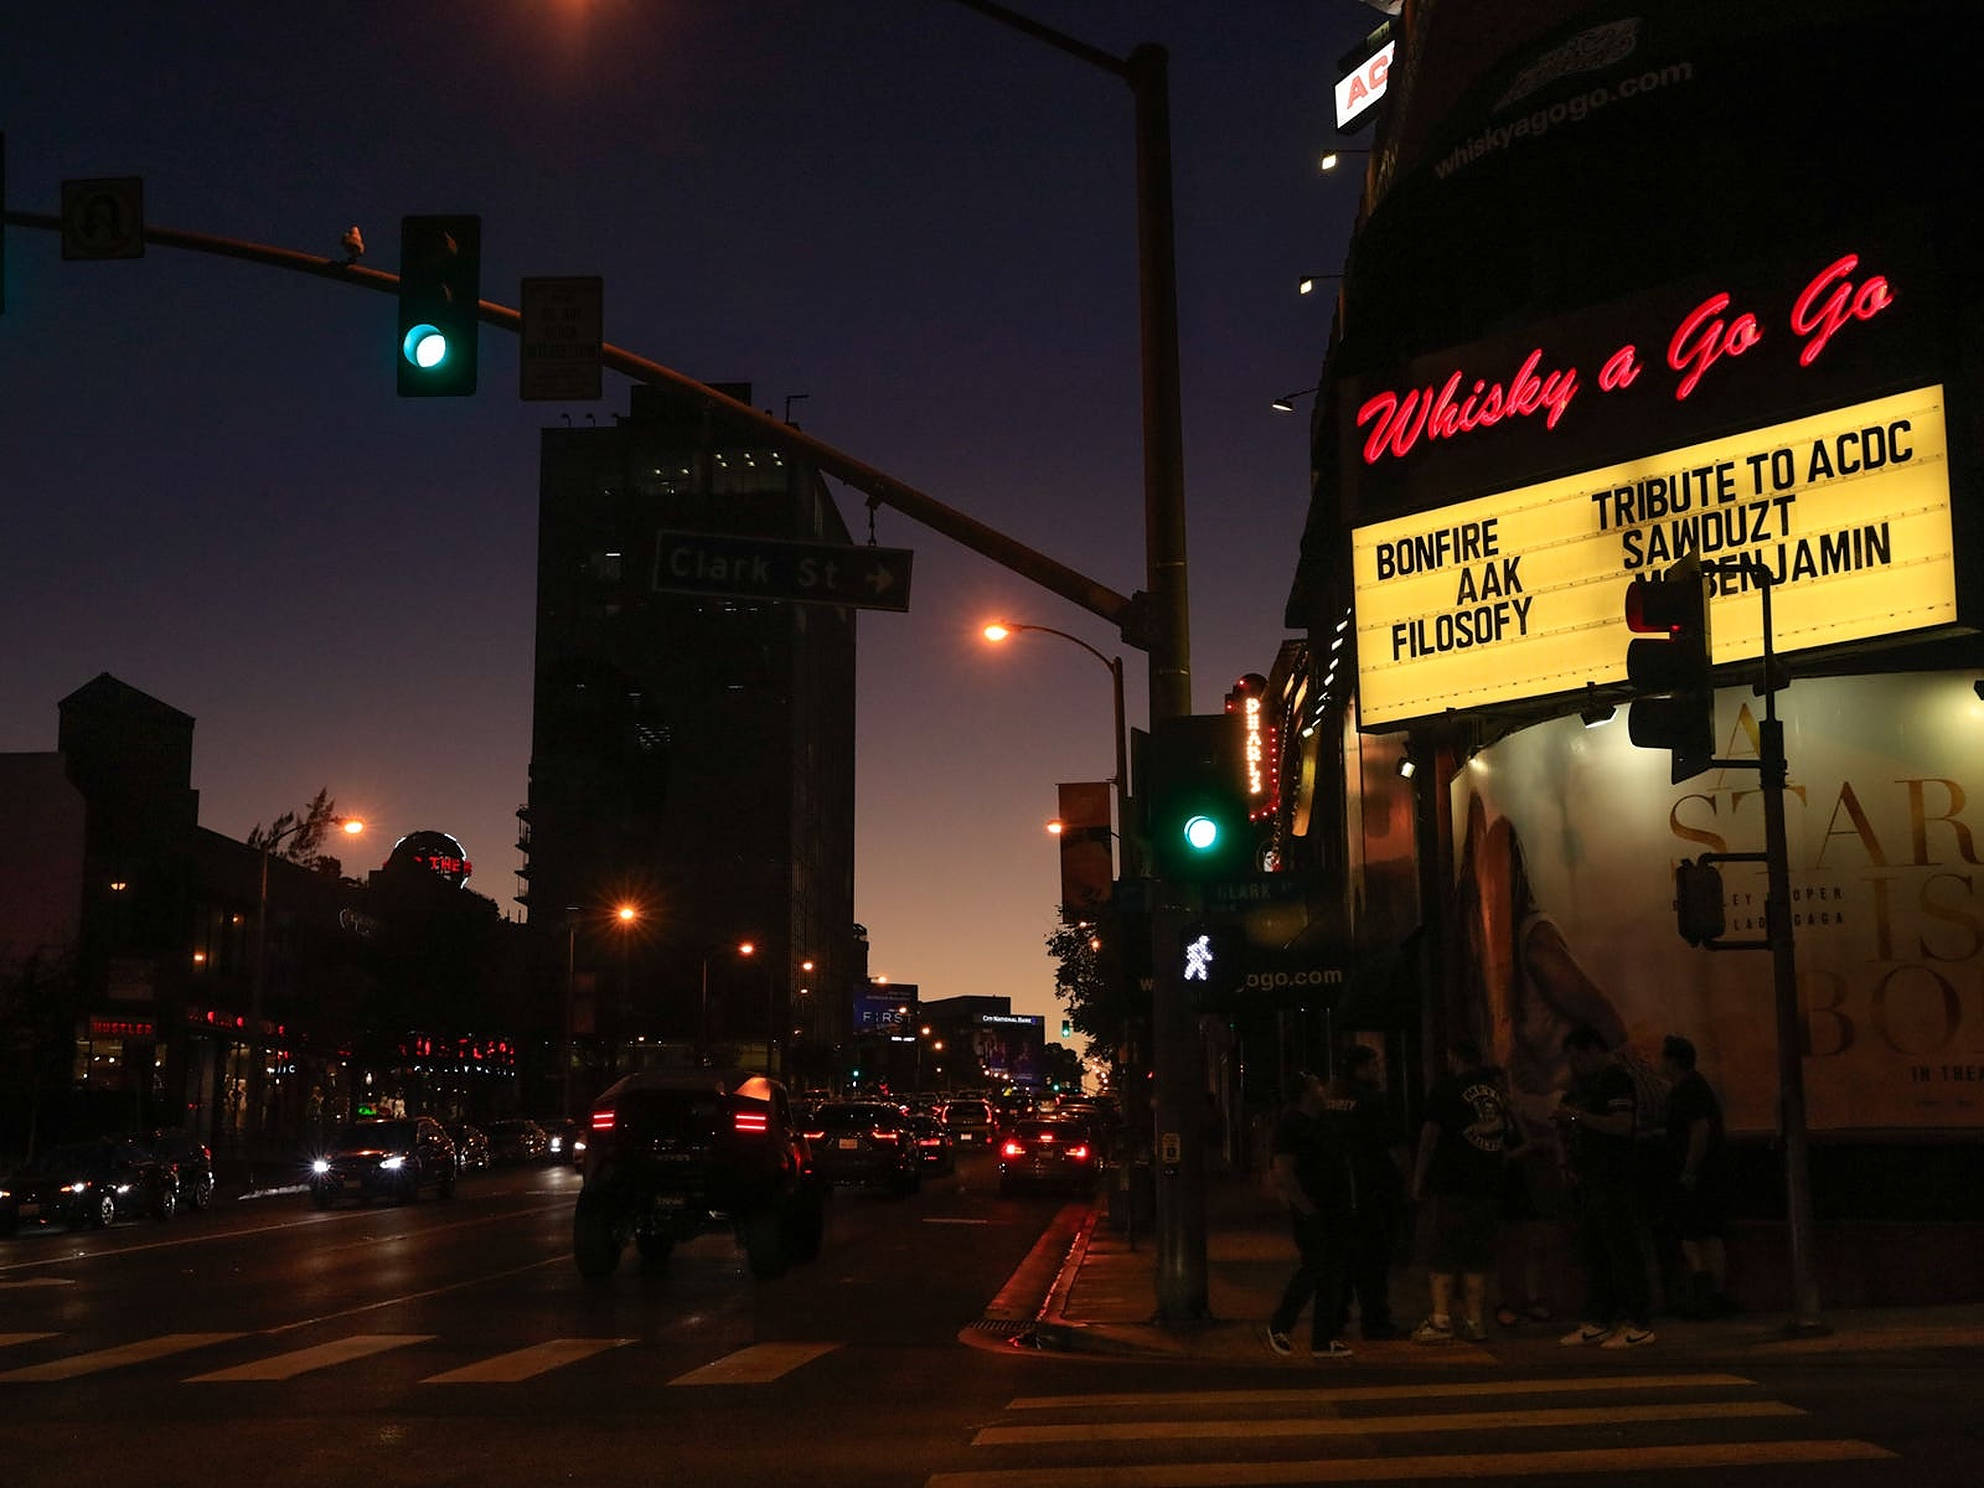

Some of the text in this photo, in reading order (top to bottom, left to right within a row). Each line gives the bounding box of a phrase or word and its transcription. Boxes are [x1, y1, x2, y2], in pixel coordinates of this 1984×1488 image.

[1433, 61, 1694, 180] whiskyagogo.com
[1357, 253, 1894, 465] Whisky a Go Go
[1591, 419, 1914, 531] TRIBUTE TO ACDC
[1376, 518, 1499, 581] BONFIRE
[1622, 494, 1796, 570] SAWDUZT
[1698, 522, 1891, 599] BENJAMIN
[669, 546, 840, 590] Clark St
[1457, 555, 1523, 606] AAK
[1392, 596, 1533, 661] FILOSOFY
[1794, 912, 1844, 927] GAGA
[1246, 967, 1344, 992] ogo.com
[1796, 962, 1984, 1060] BO
